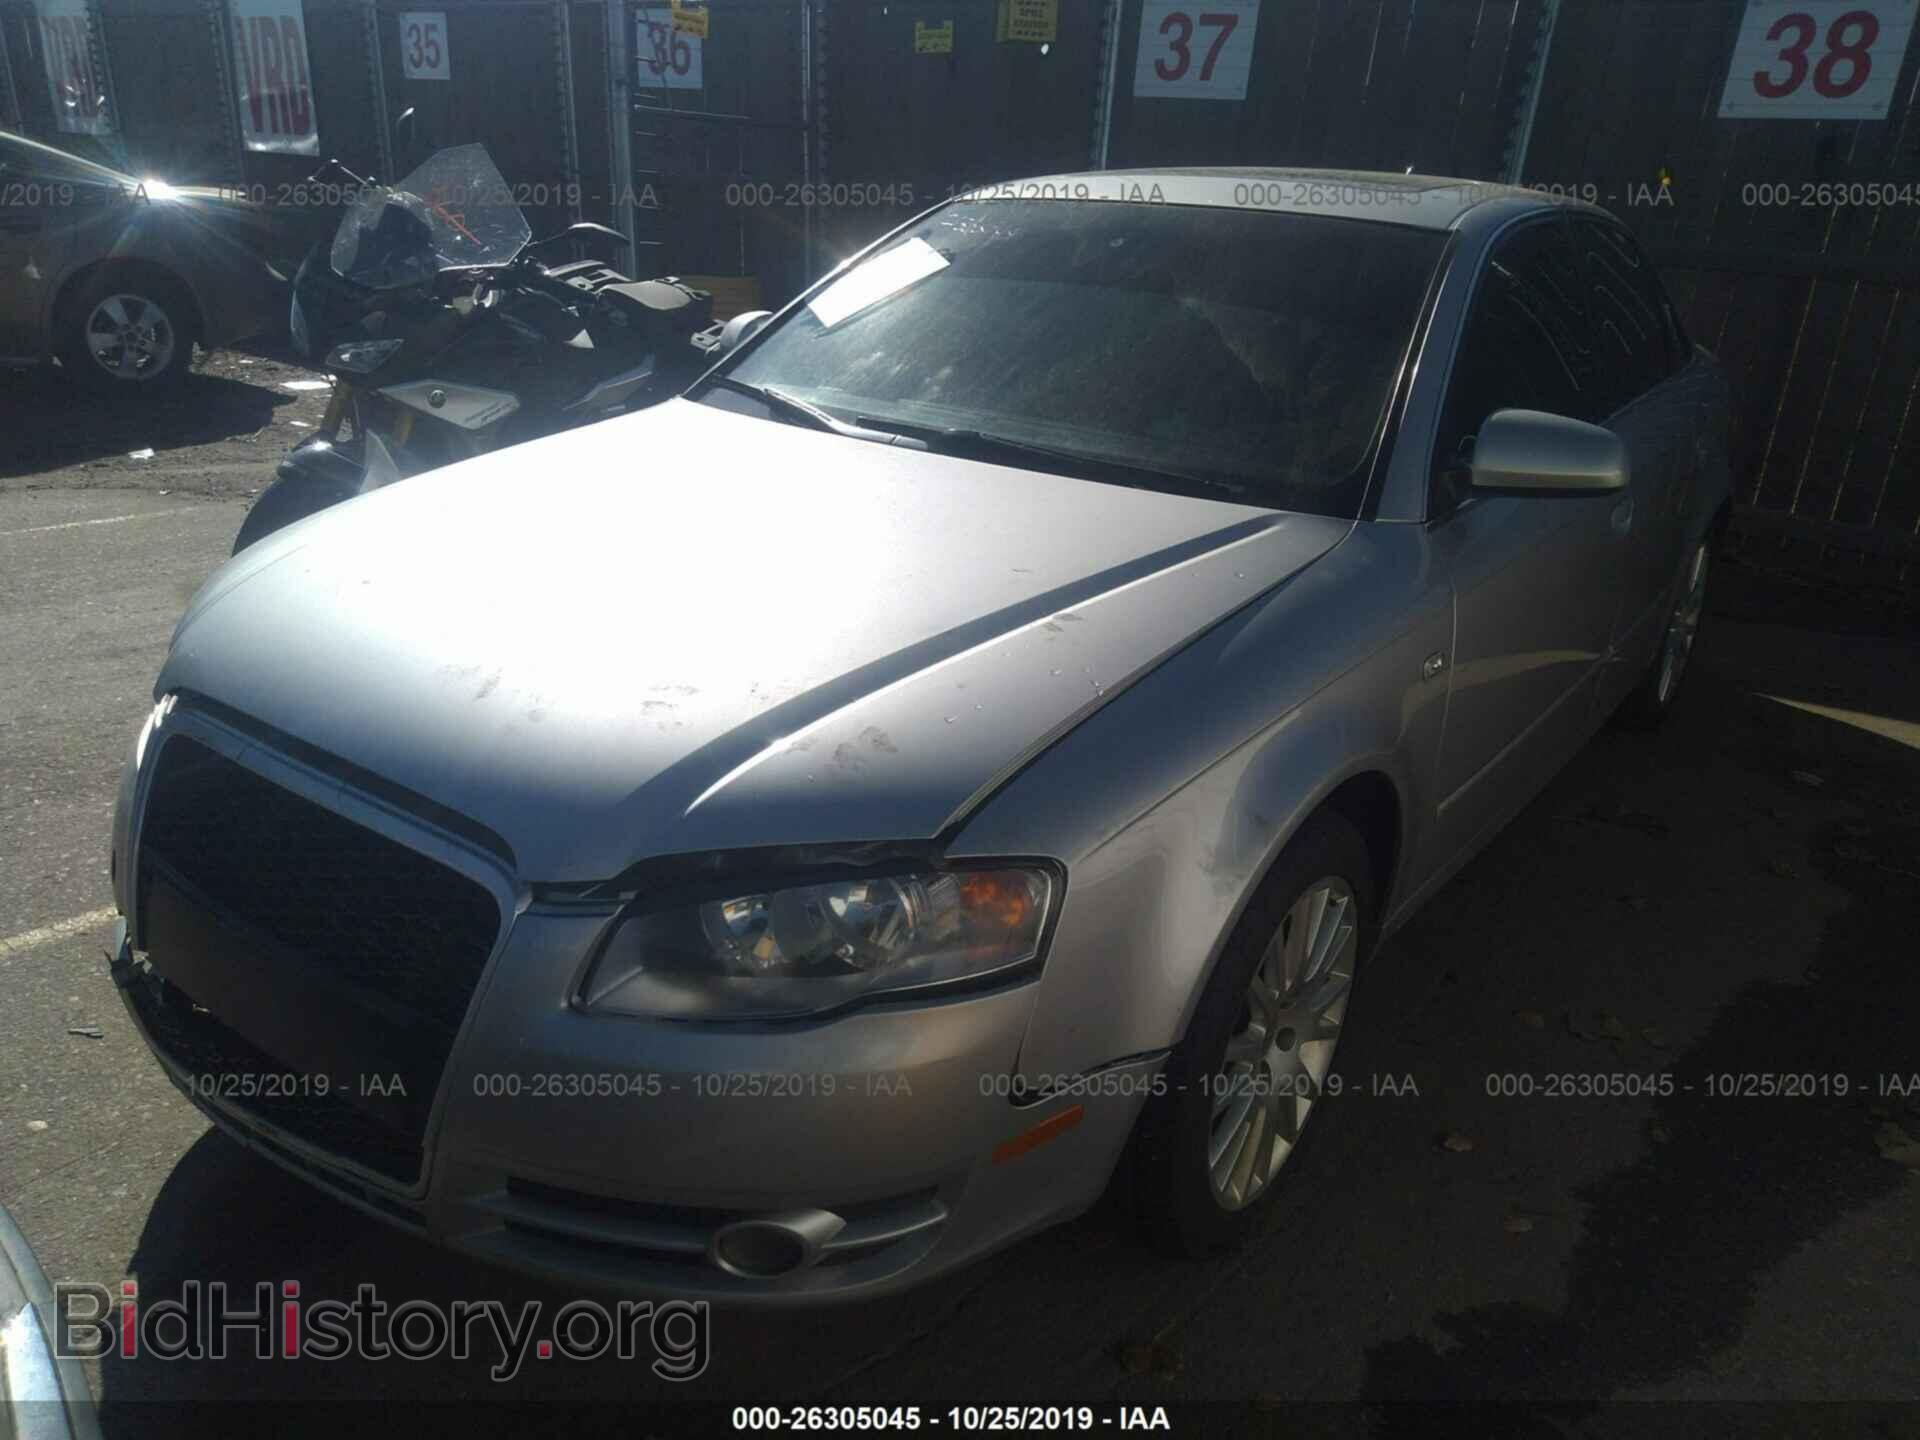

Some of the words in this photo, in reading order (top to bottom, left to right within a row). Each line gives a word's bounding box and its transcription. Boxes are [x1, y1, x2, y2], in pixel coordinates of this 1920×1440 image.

[406, 23, 441, 69] 35
[648, 23, 692, 76] 36
[1153, 13, 1240, 82] 37
[1752, 11, 1880, 99] 38
